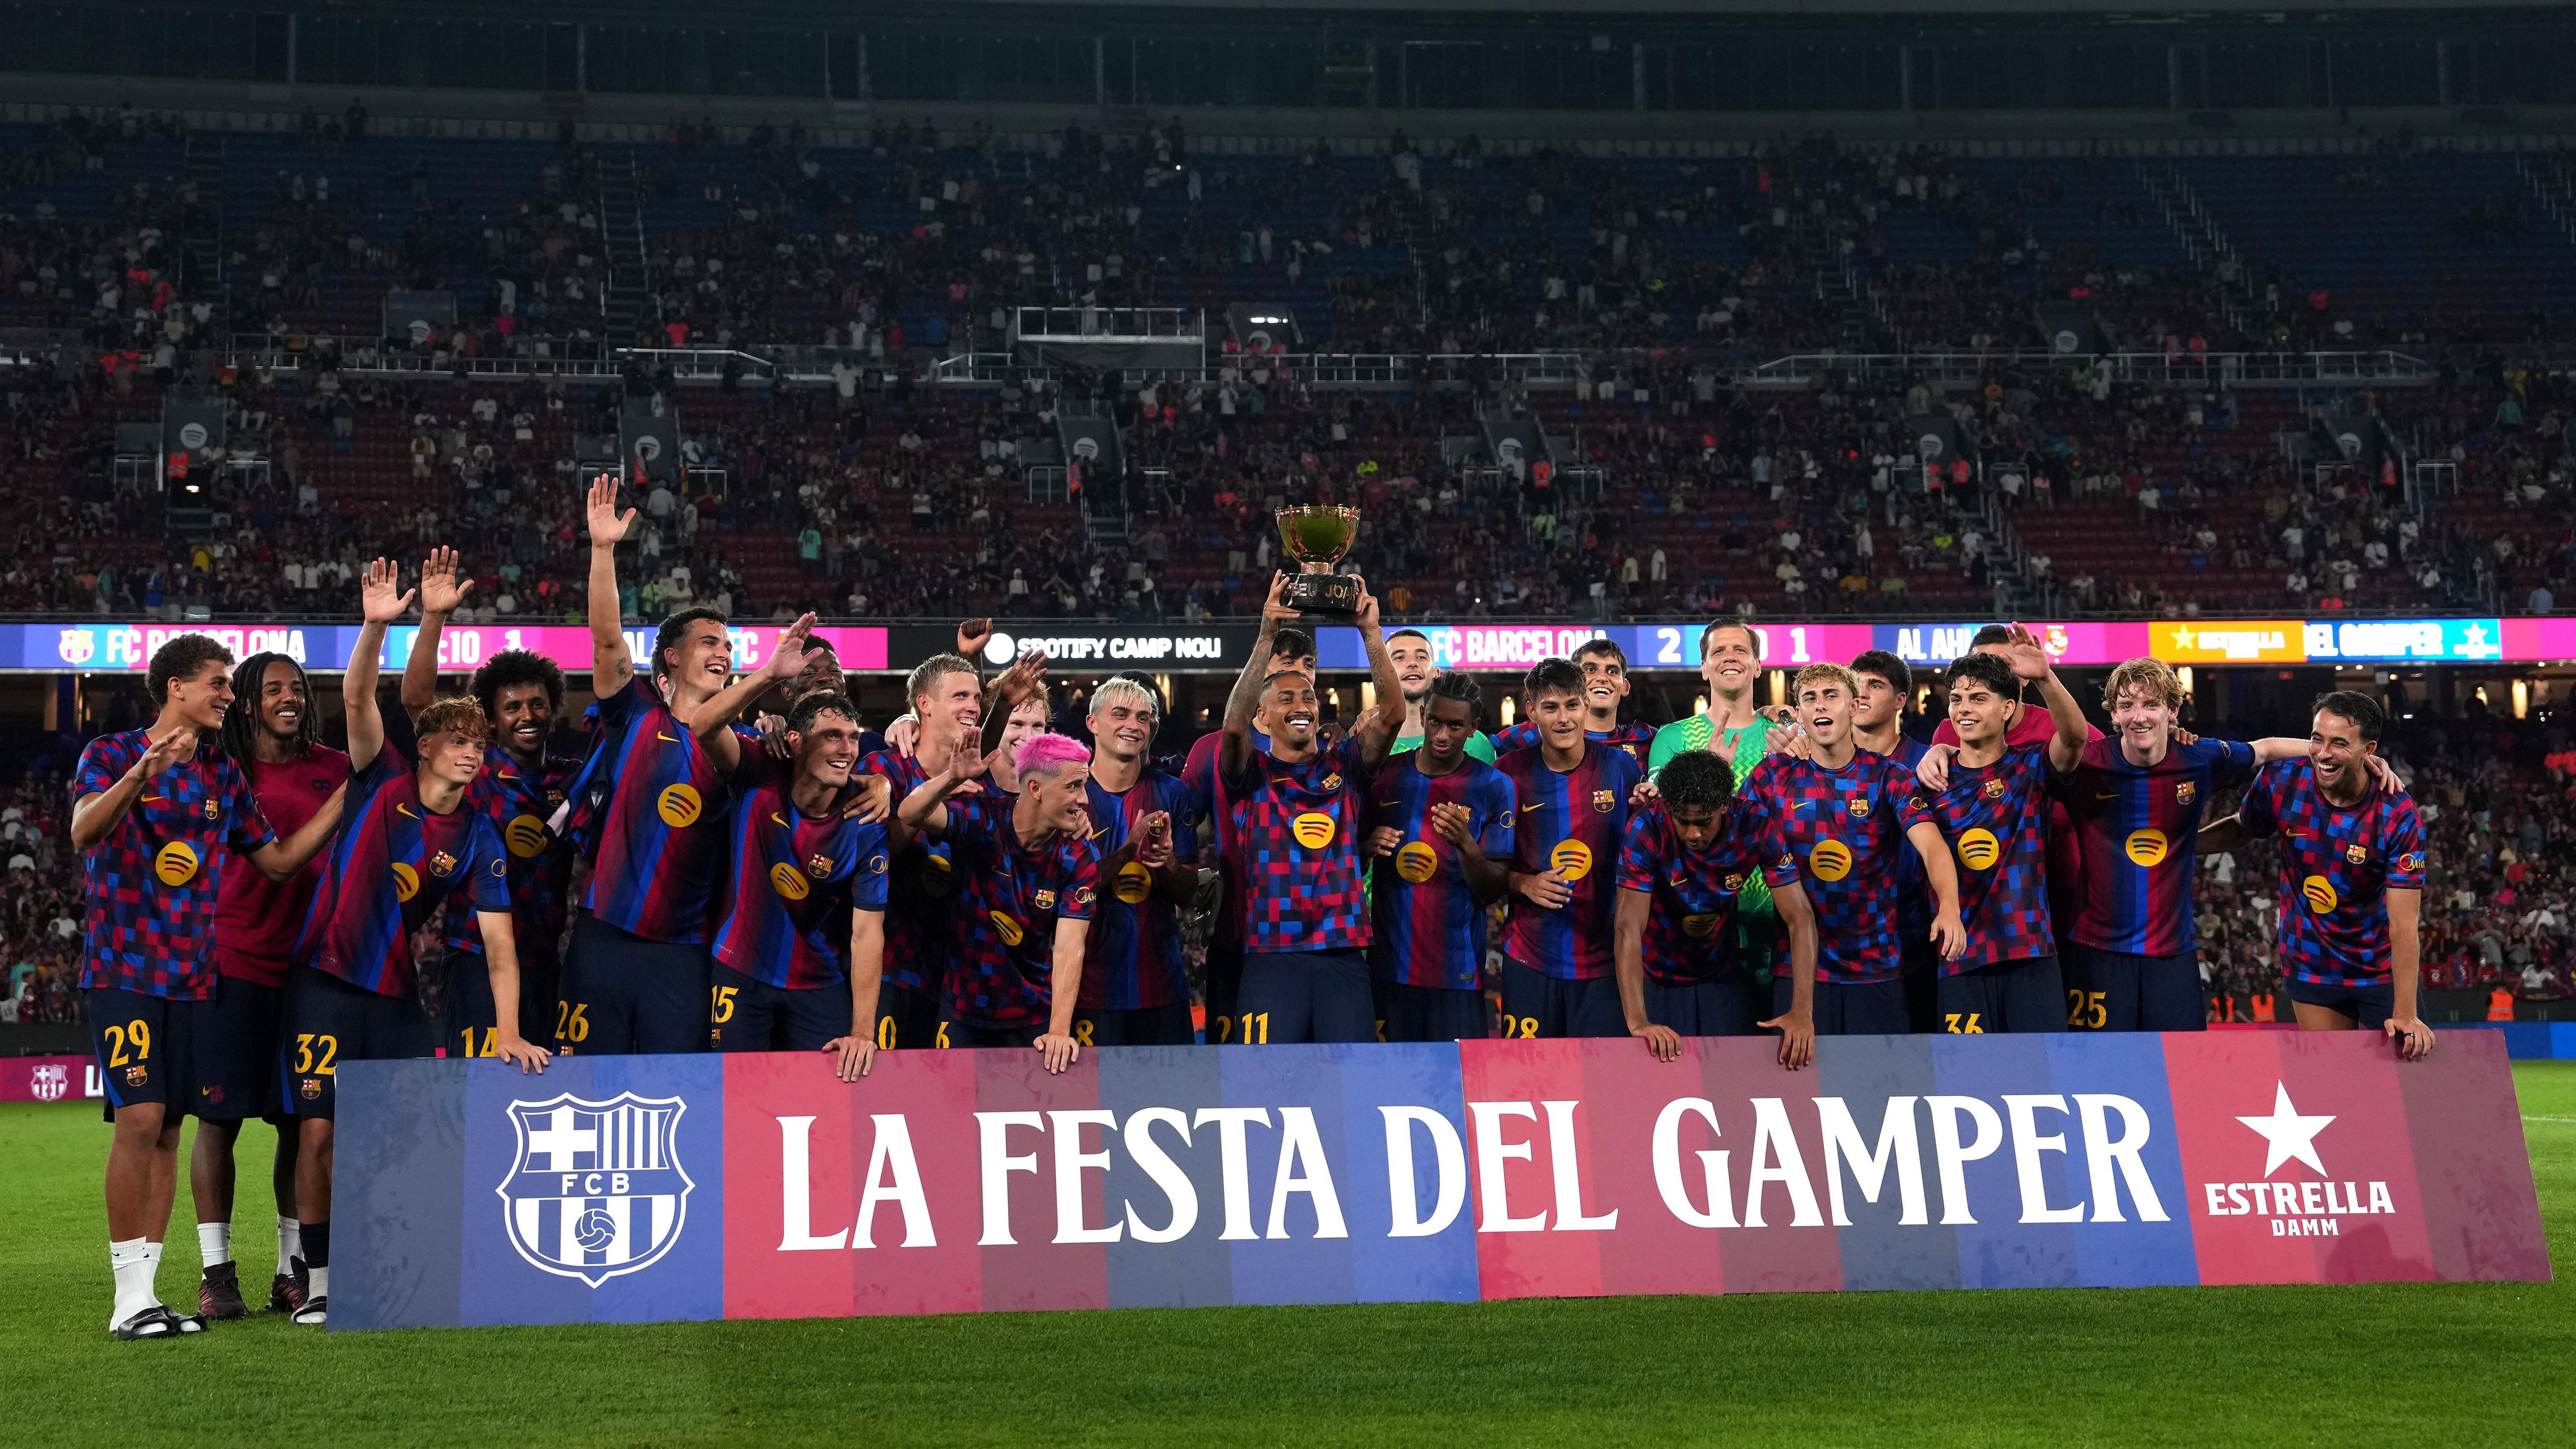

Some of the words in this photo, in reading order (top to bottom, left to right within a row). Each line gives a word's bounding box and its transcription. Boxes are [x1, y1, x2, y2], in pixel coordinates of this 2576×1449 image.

[107, 629, 142, 663] FC
[1017, 638, 1107, 659] SPOTIFY
[1110, 638, 1172, 659] CAMP
[1175, 637, 1221, 658] NOU
[1431, 630, 1462, 663] FC
[1657, 628, 1682, 663] 2
[1790, 627, 1810, 662] 1
[1896, 628, 1927, 660] AL
[555, 1000, 589, 1042] 26
[712, 985, 739, 1023] 15
[2068, 989, 2107, 1028] 25
[105, 1019, 150, 1068] 29
[461, 1026, 500, 1057] 14
[1242, 1012, 1268, 1044] 11
[1504, 1014, 1539, 1039] 28
[295, 1034, 337, 1075] 32
[561, 1172, 630, 1195] FCB
[775, 1114, 937, 1251] LA
[973, 1107, 1349, 1246] FESTA
[1377, 1100, 1619, 1238] DEL
[1652, 1093, 2171, 1228] GAMPER
[2204, 1181, 2396, 1216] ESTRELLA
[2271, 1218, 2339, 1236] DAMM
